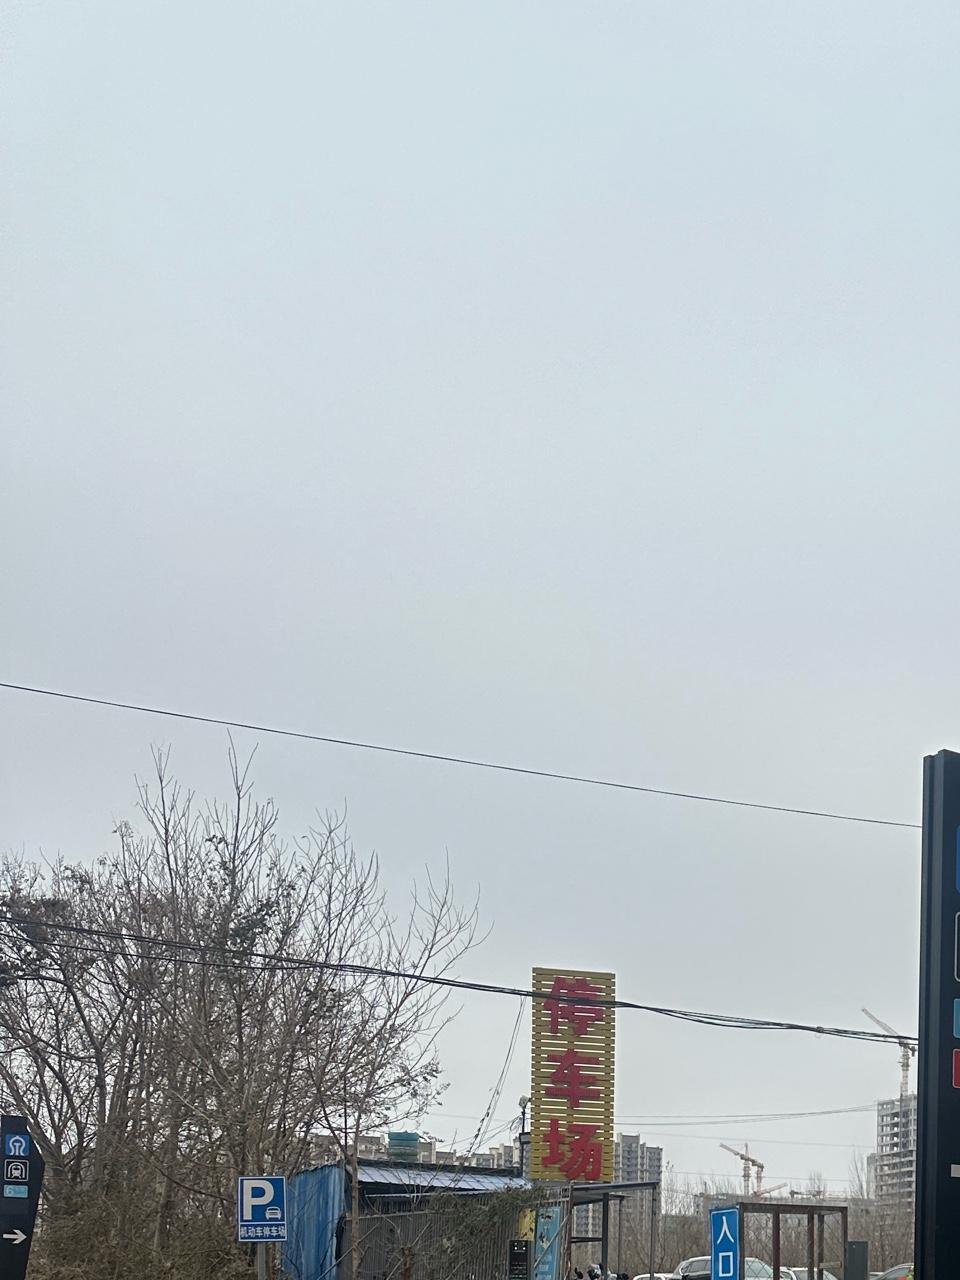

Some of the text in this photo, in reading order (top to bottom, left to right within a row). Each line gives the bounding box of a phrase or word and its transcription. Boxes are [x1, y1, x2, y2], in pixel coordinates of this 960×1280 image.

[542, 976, 604, 1181] 停车场
[243, 1180, 274, 1220] P
[240, 1226, 285, 1237] 机动车停车场
[716, 1215, 734, 1277] 入口
